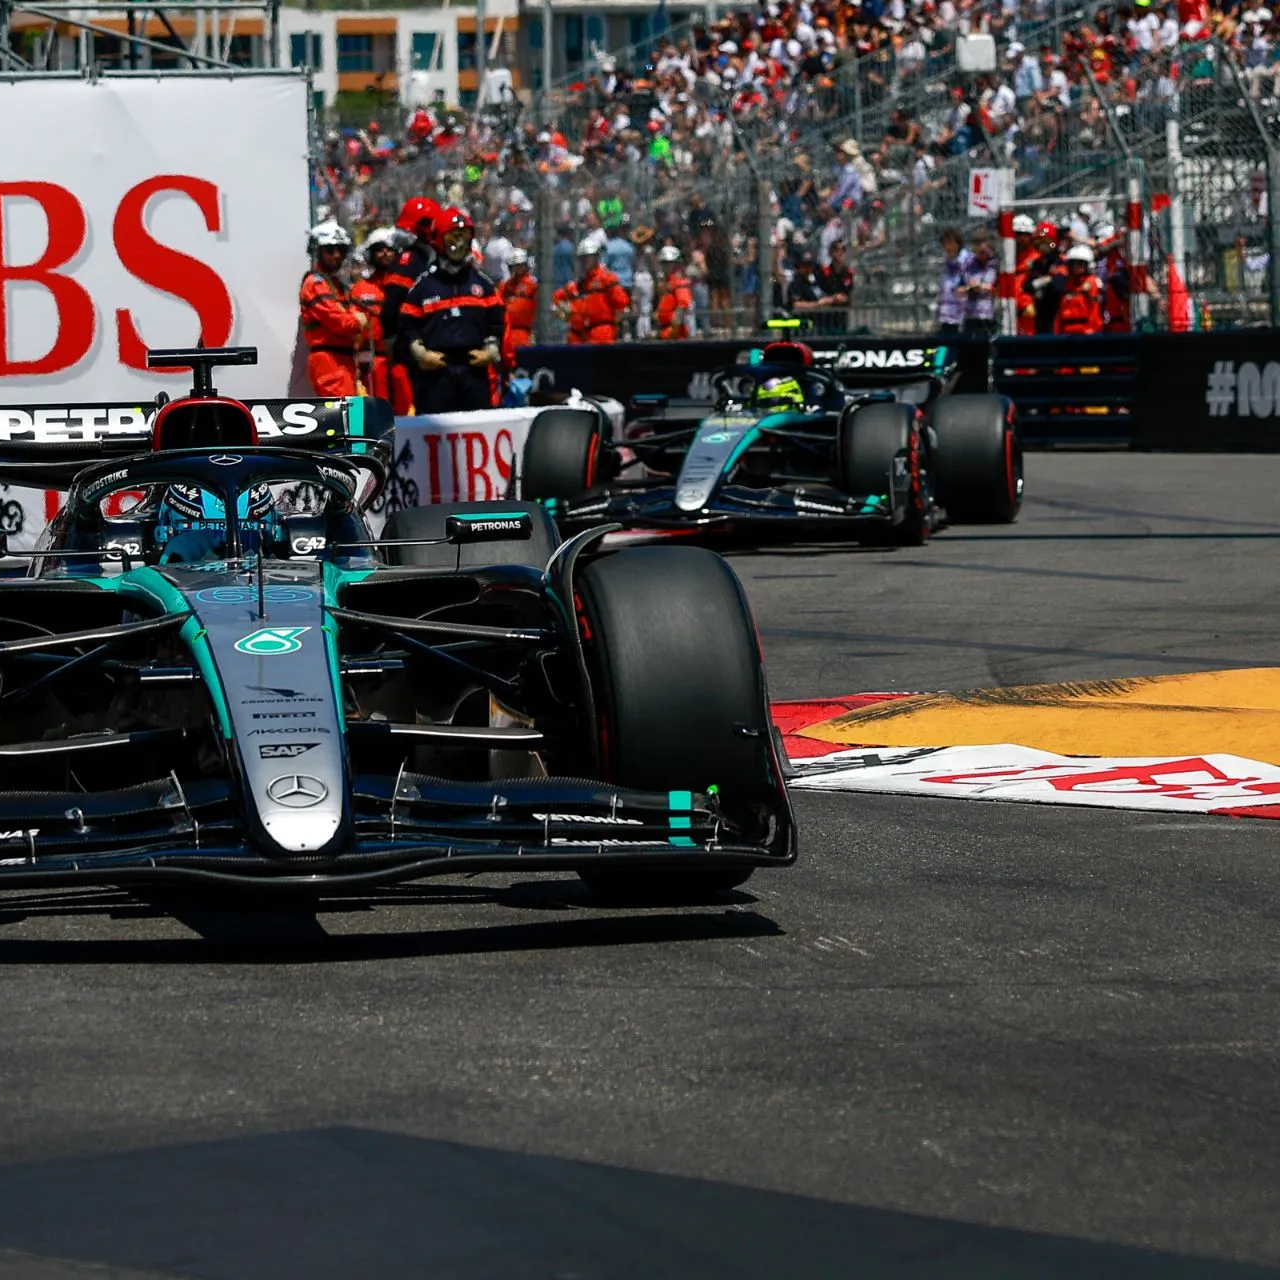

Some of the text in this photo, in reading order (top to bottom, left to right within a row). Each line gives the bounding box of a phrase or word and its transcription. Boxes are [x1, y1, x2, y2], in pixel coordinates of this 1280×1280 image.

[423, 428, 513, 504] UBS
[471, 520, 521, 532] PETRONAS
[292, 537, 326, 555] G42
[261, 745, 308, 757] SAP
